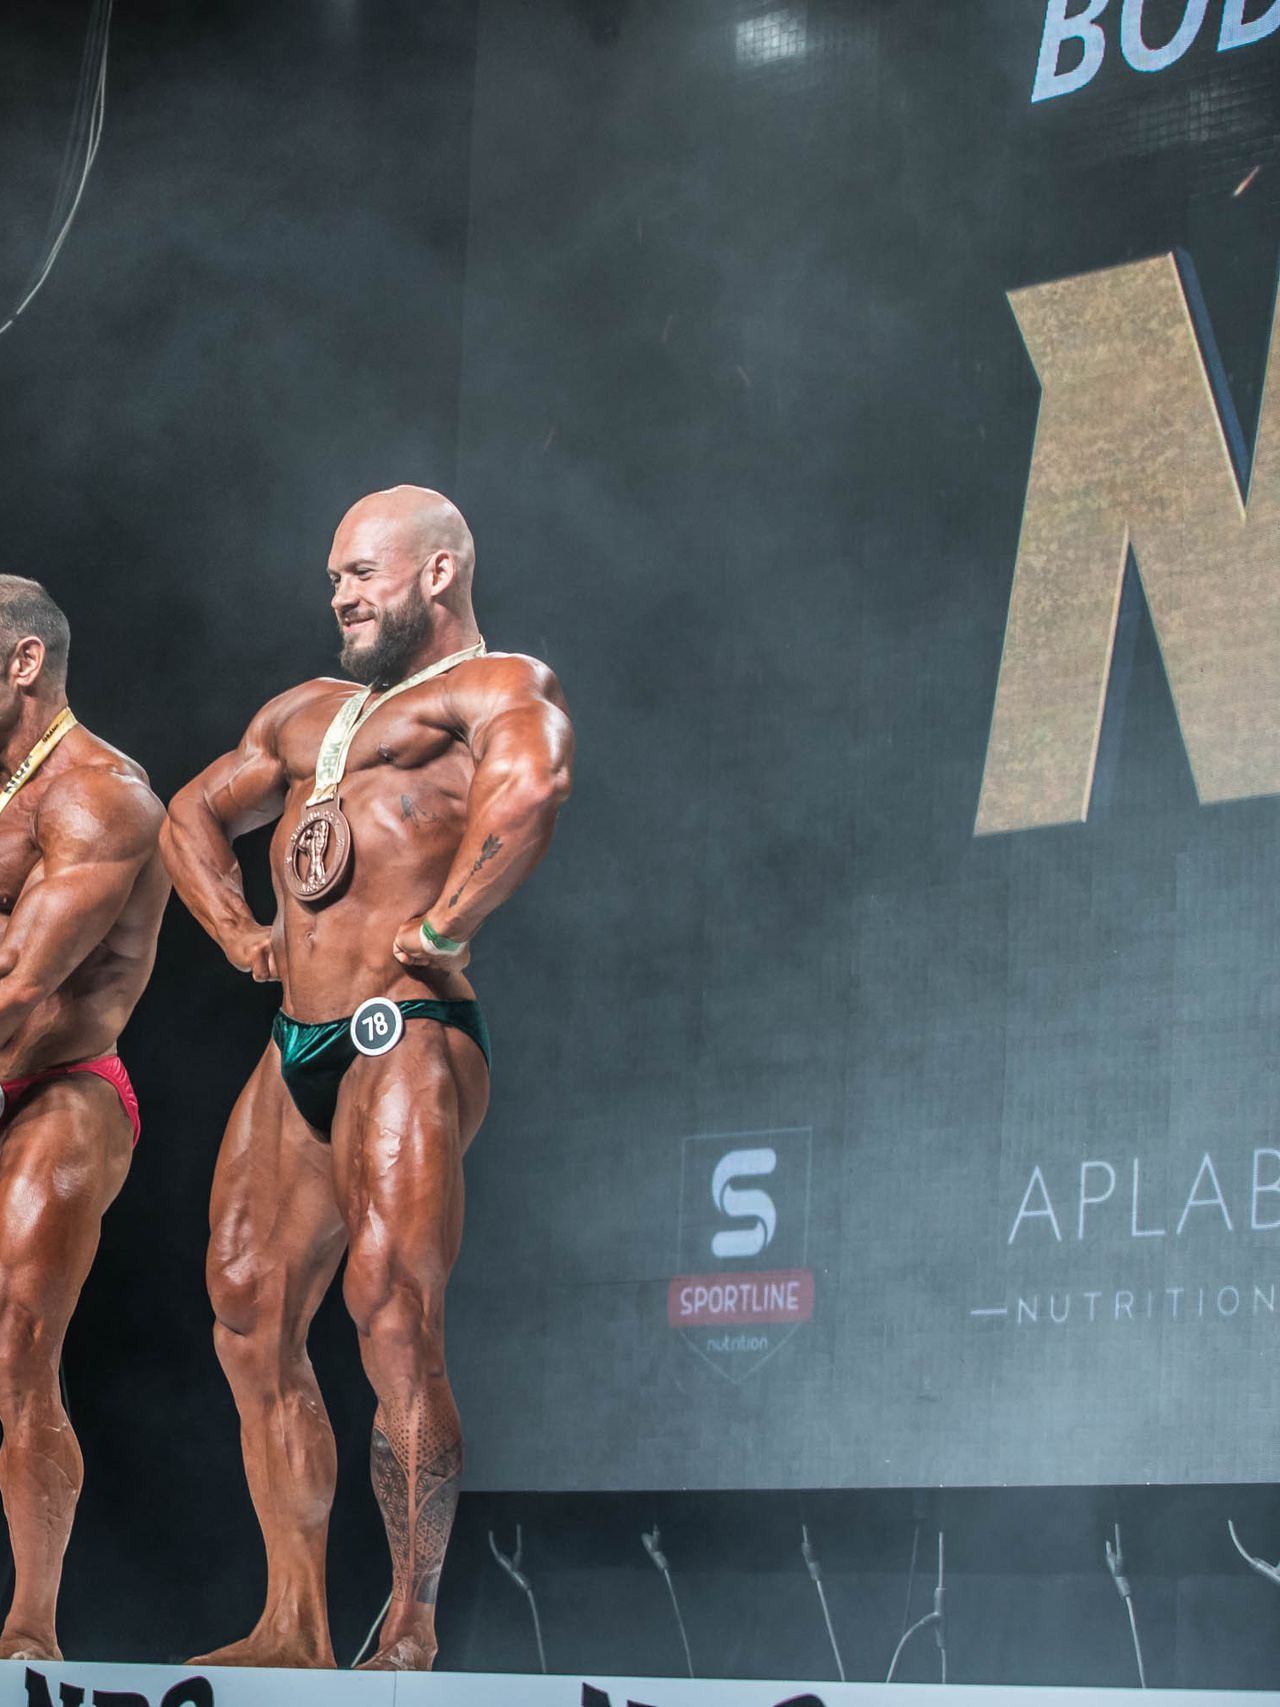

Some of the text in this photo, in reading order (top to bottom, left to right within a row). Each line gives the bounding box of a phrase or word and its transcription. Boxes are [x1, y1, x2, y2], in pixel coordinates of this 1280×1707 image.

[361, 1011, 389, 1042] 78
[680, 1281, 800, 1316] SPORTLINE
[1017, 1284, 1275, 1325] NUTRITION
[706, 1333, 769, 1353] nutrition
